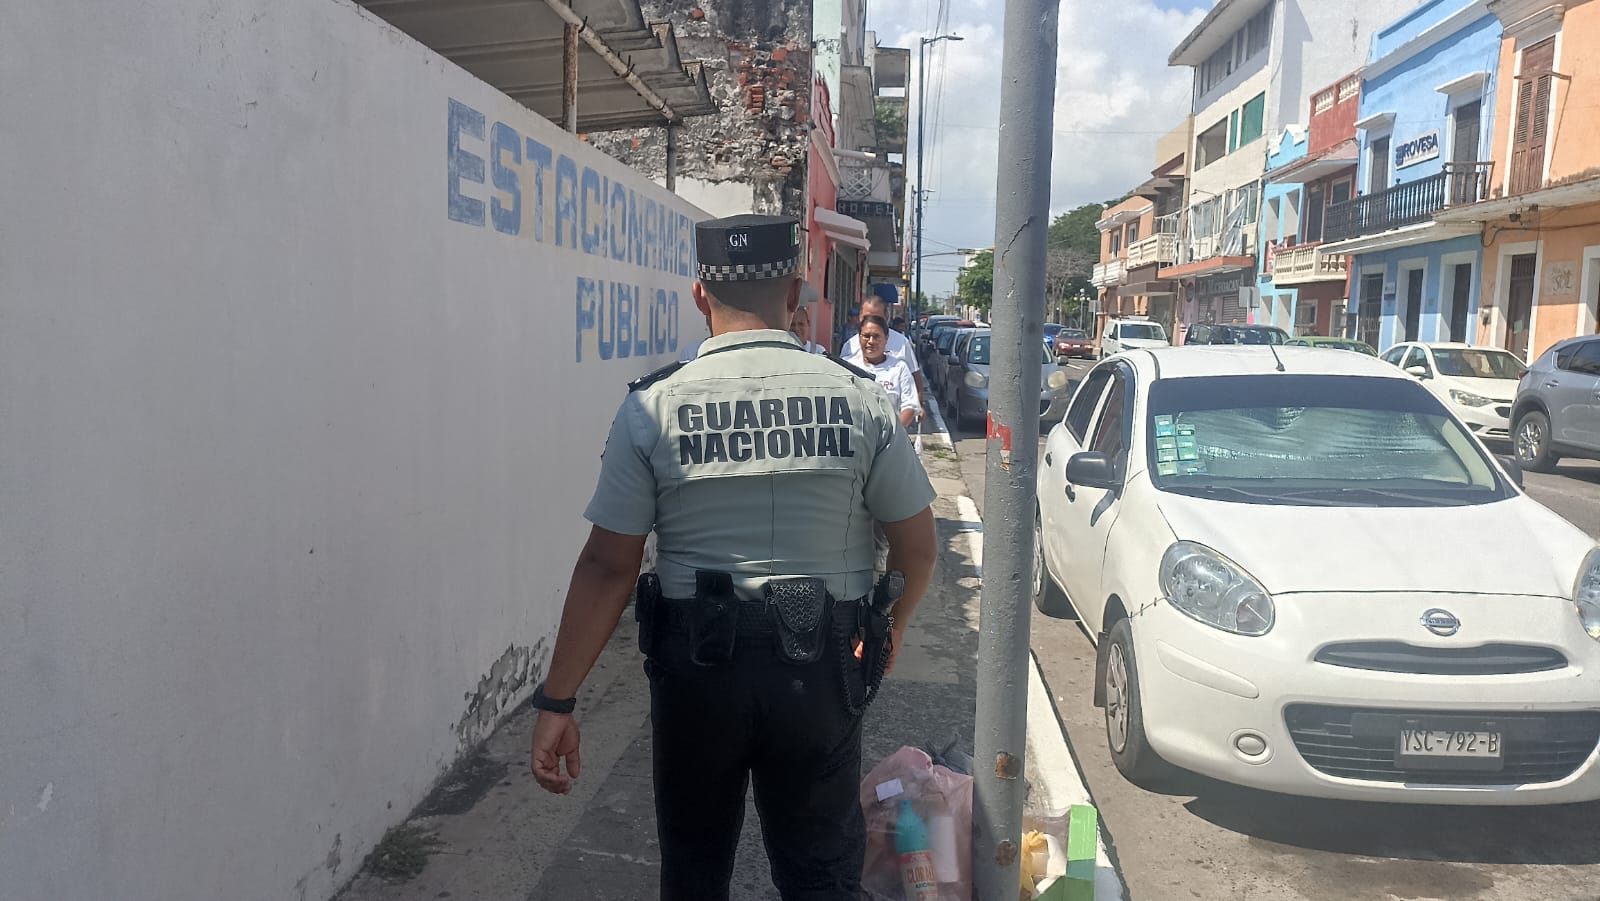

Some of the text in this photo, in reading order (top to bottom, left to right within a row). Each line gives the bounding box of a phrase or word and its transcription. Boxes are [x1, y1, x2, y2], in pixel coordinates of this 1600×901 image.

[838, 201, 893, 216] HOTEL
[729, 233, 748, 247] GN
[677, 396, 854, 432] GUARDIA
[679, 427, 855, 466] NACIONAL
[1402, 730, 1499, 753] YSC-792-B
